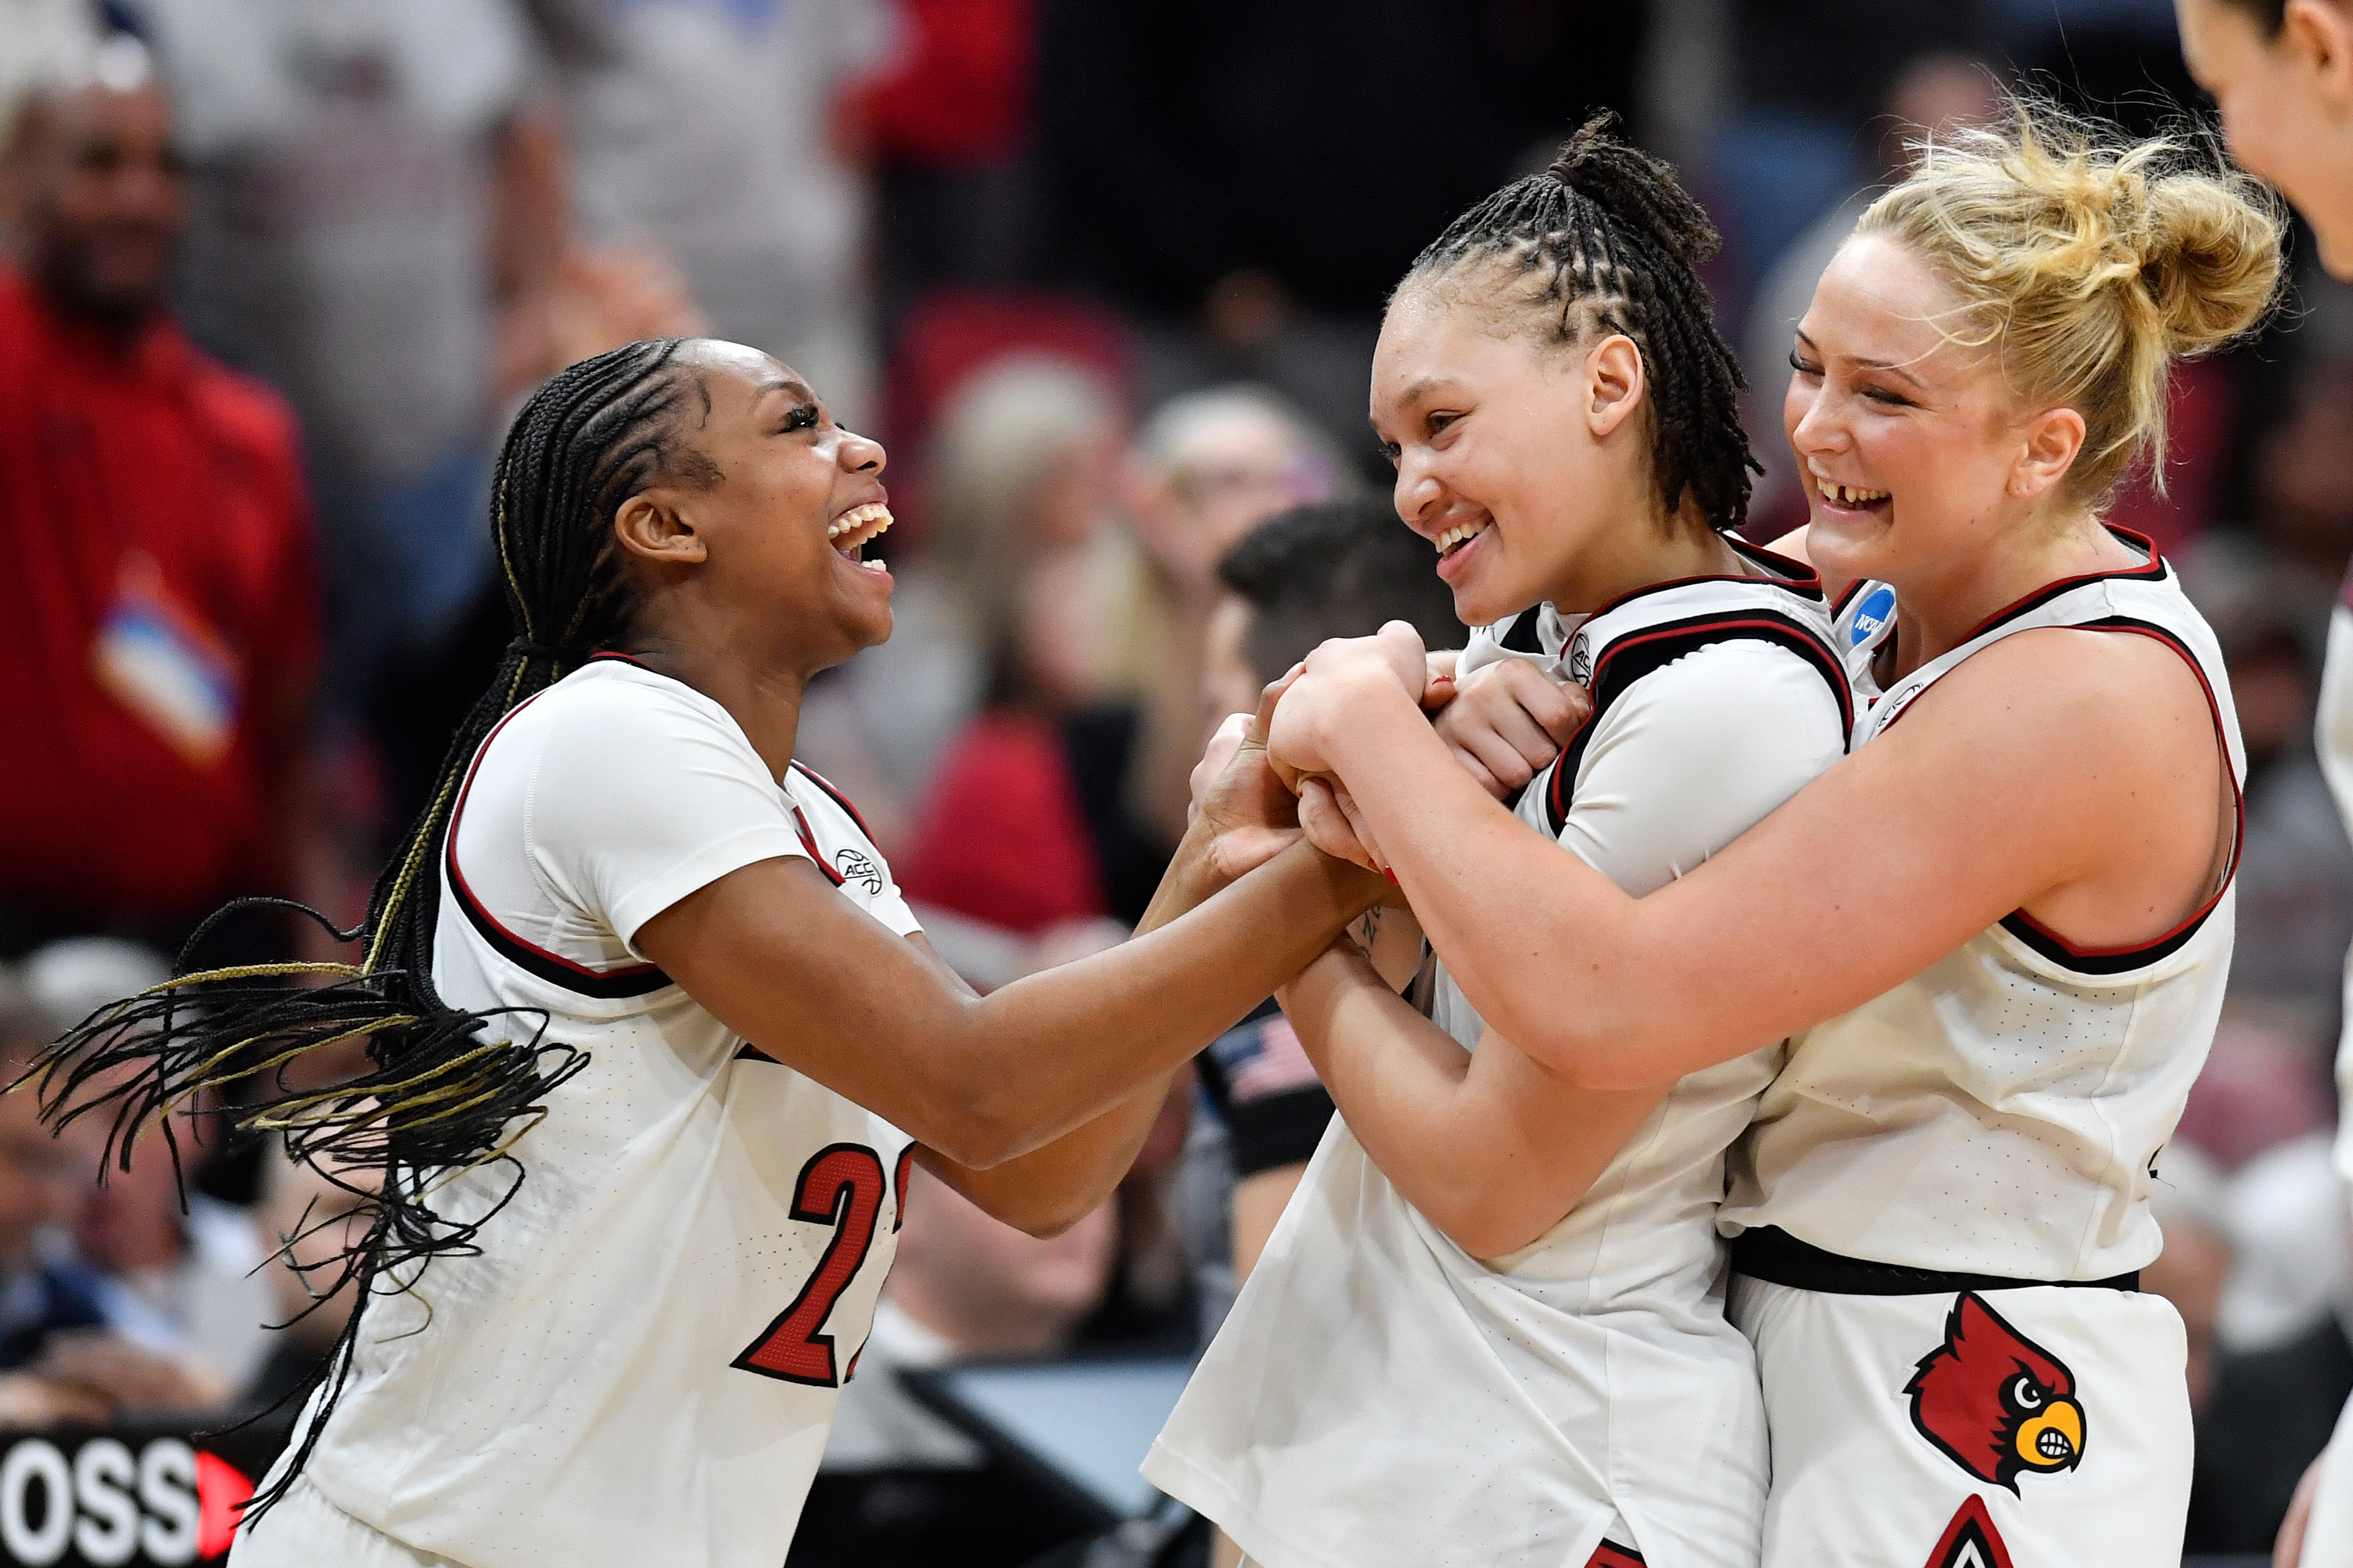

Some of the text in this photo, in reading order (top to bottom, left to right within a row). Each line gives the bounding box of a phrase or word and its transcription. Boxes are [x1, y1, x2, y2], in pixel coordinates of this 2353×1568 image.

[1575, 650, 1591, 673] AC
[844, 862, 874, 876] ACC
[730, 1141, 915, 1388] 2
[1, 1438, 202, 1567] OSS
